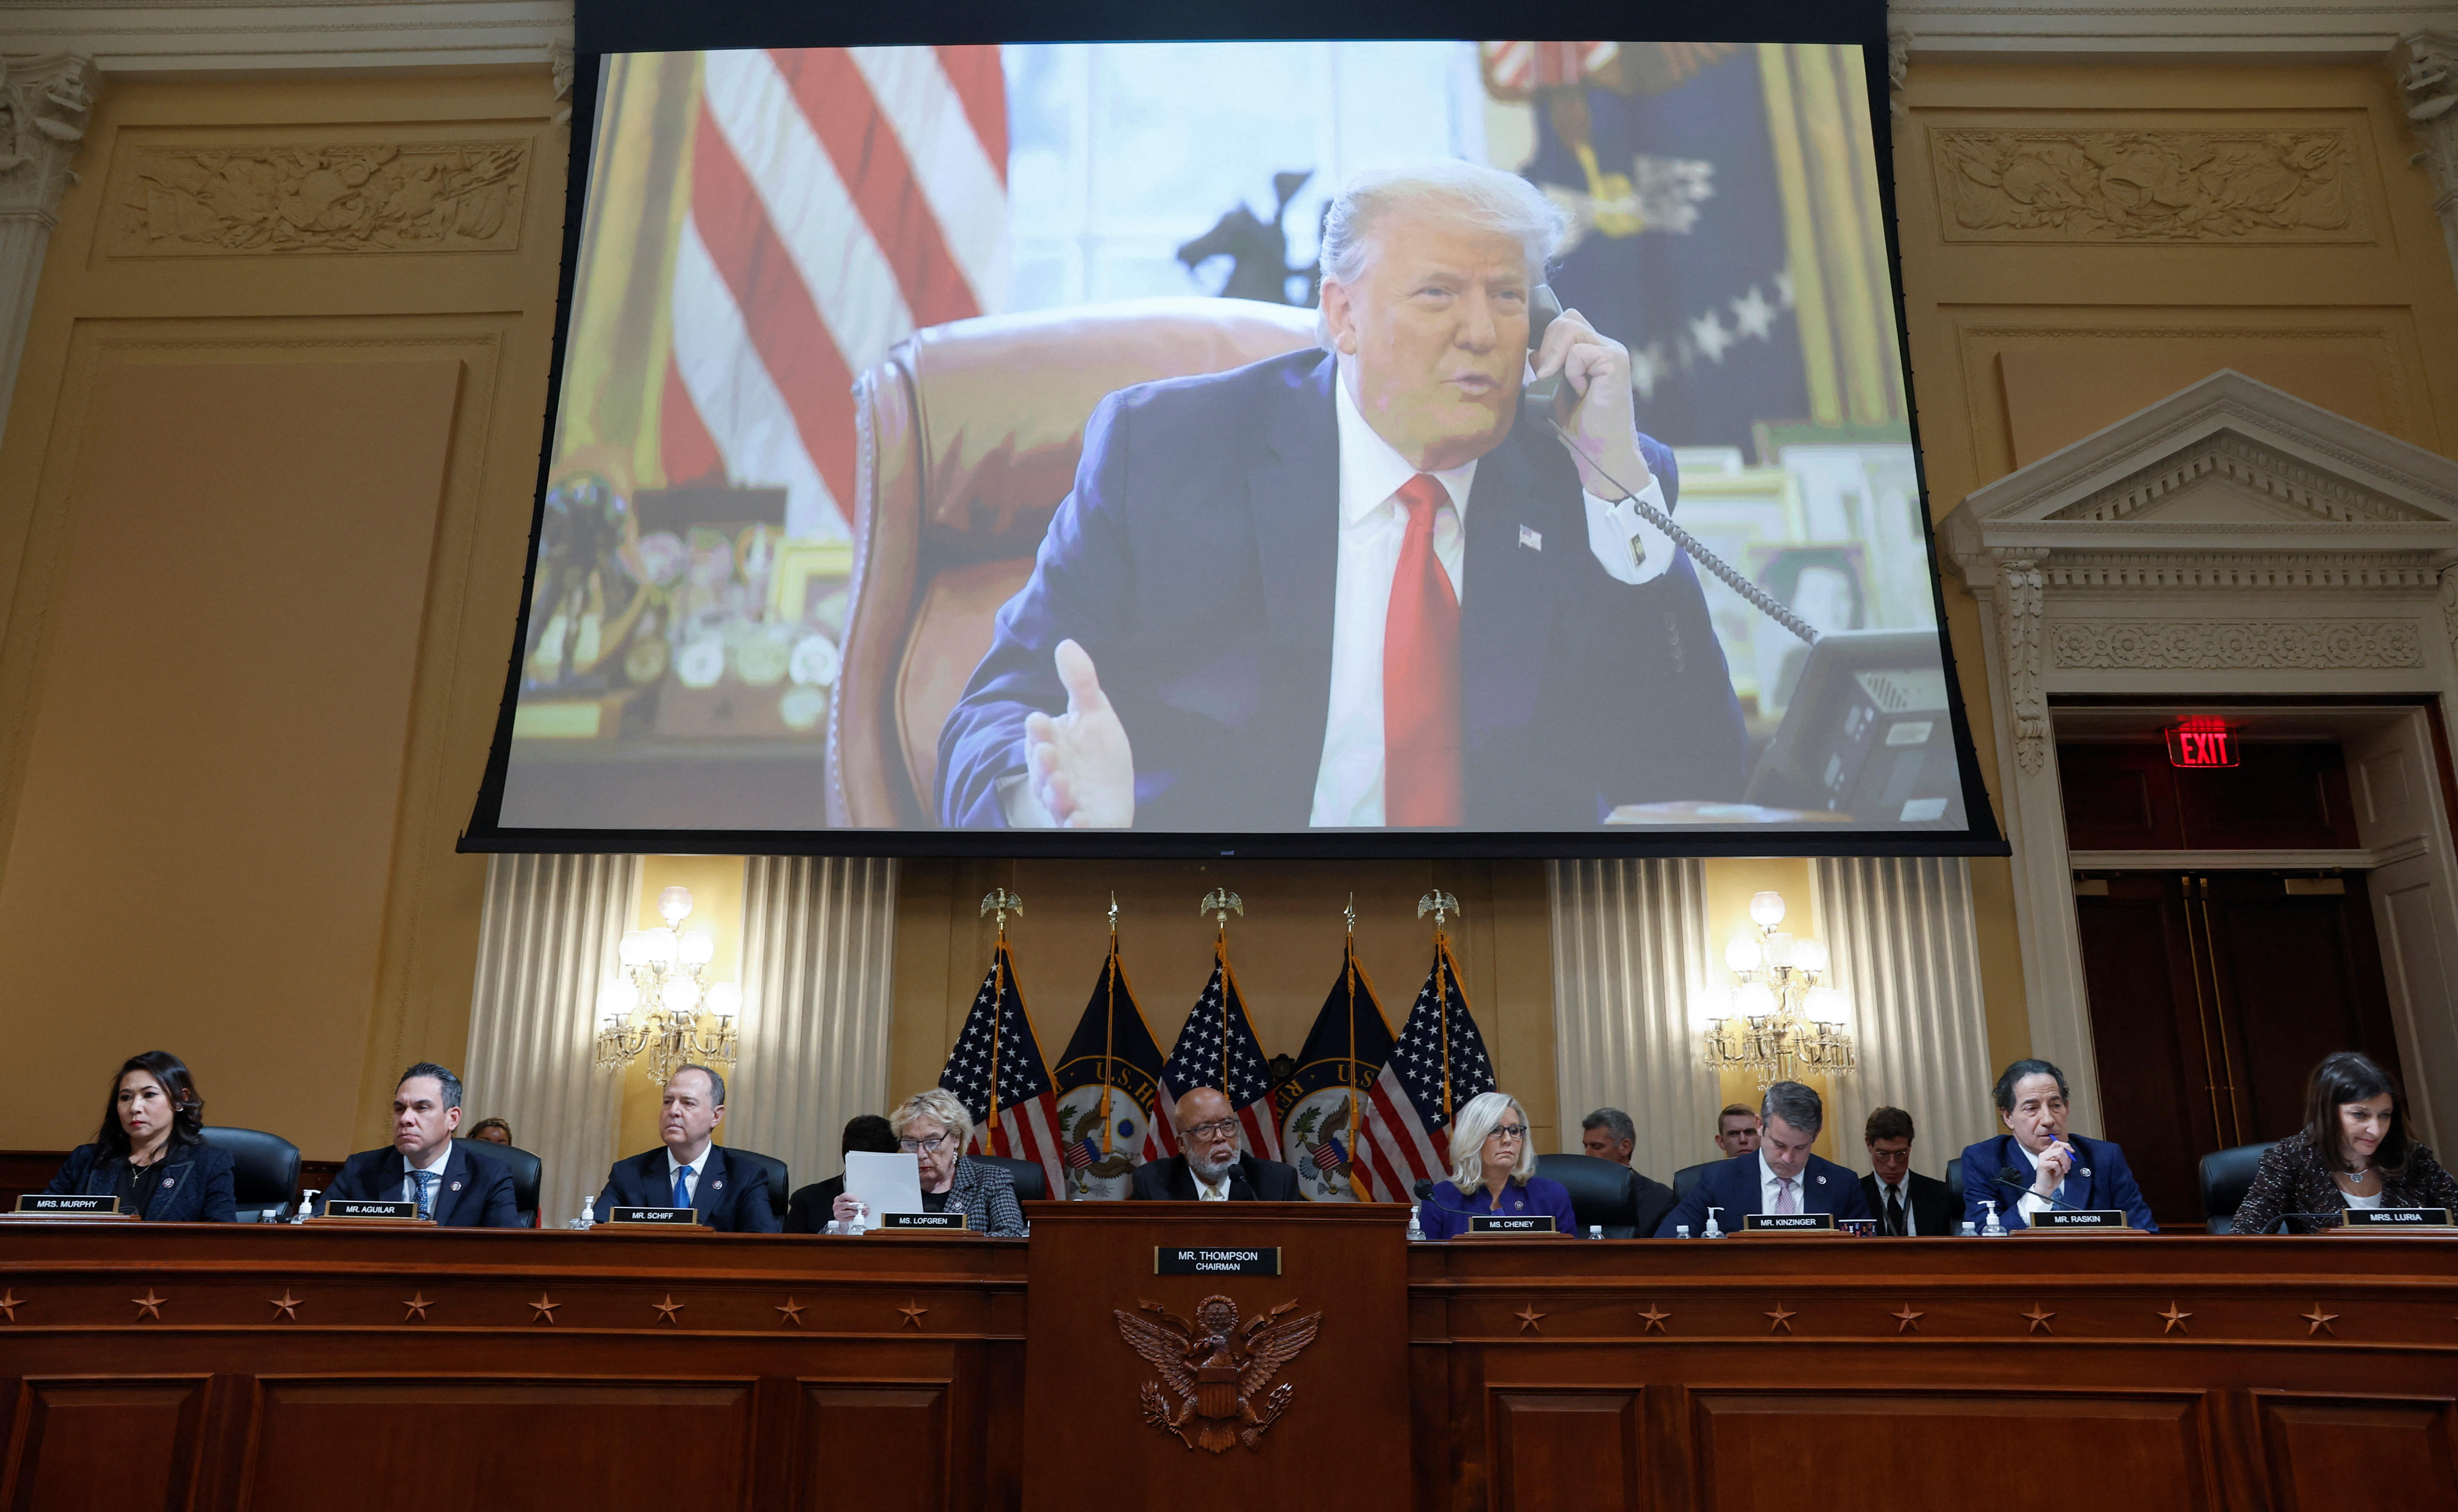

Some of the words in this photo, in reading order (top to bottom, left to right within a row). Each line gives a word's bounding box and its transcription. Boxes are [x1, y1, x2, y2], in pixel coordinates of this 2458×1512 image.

[2180, 733, 2228, 764] EXIT
[1338, 1064, 1374, 1087] U.S
[1178, 1251, 1197, 1260] MR.
[1199, 1251, 1258, 1261] THOMPSON
